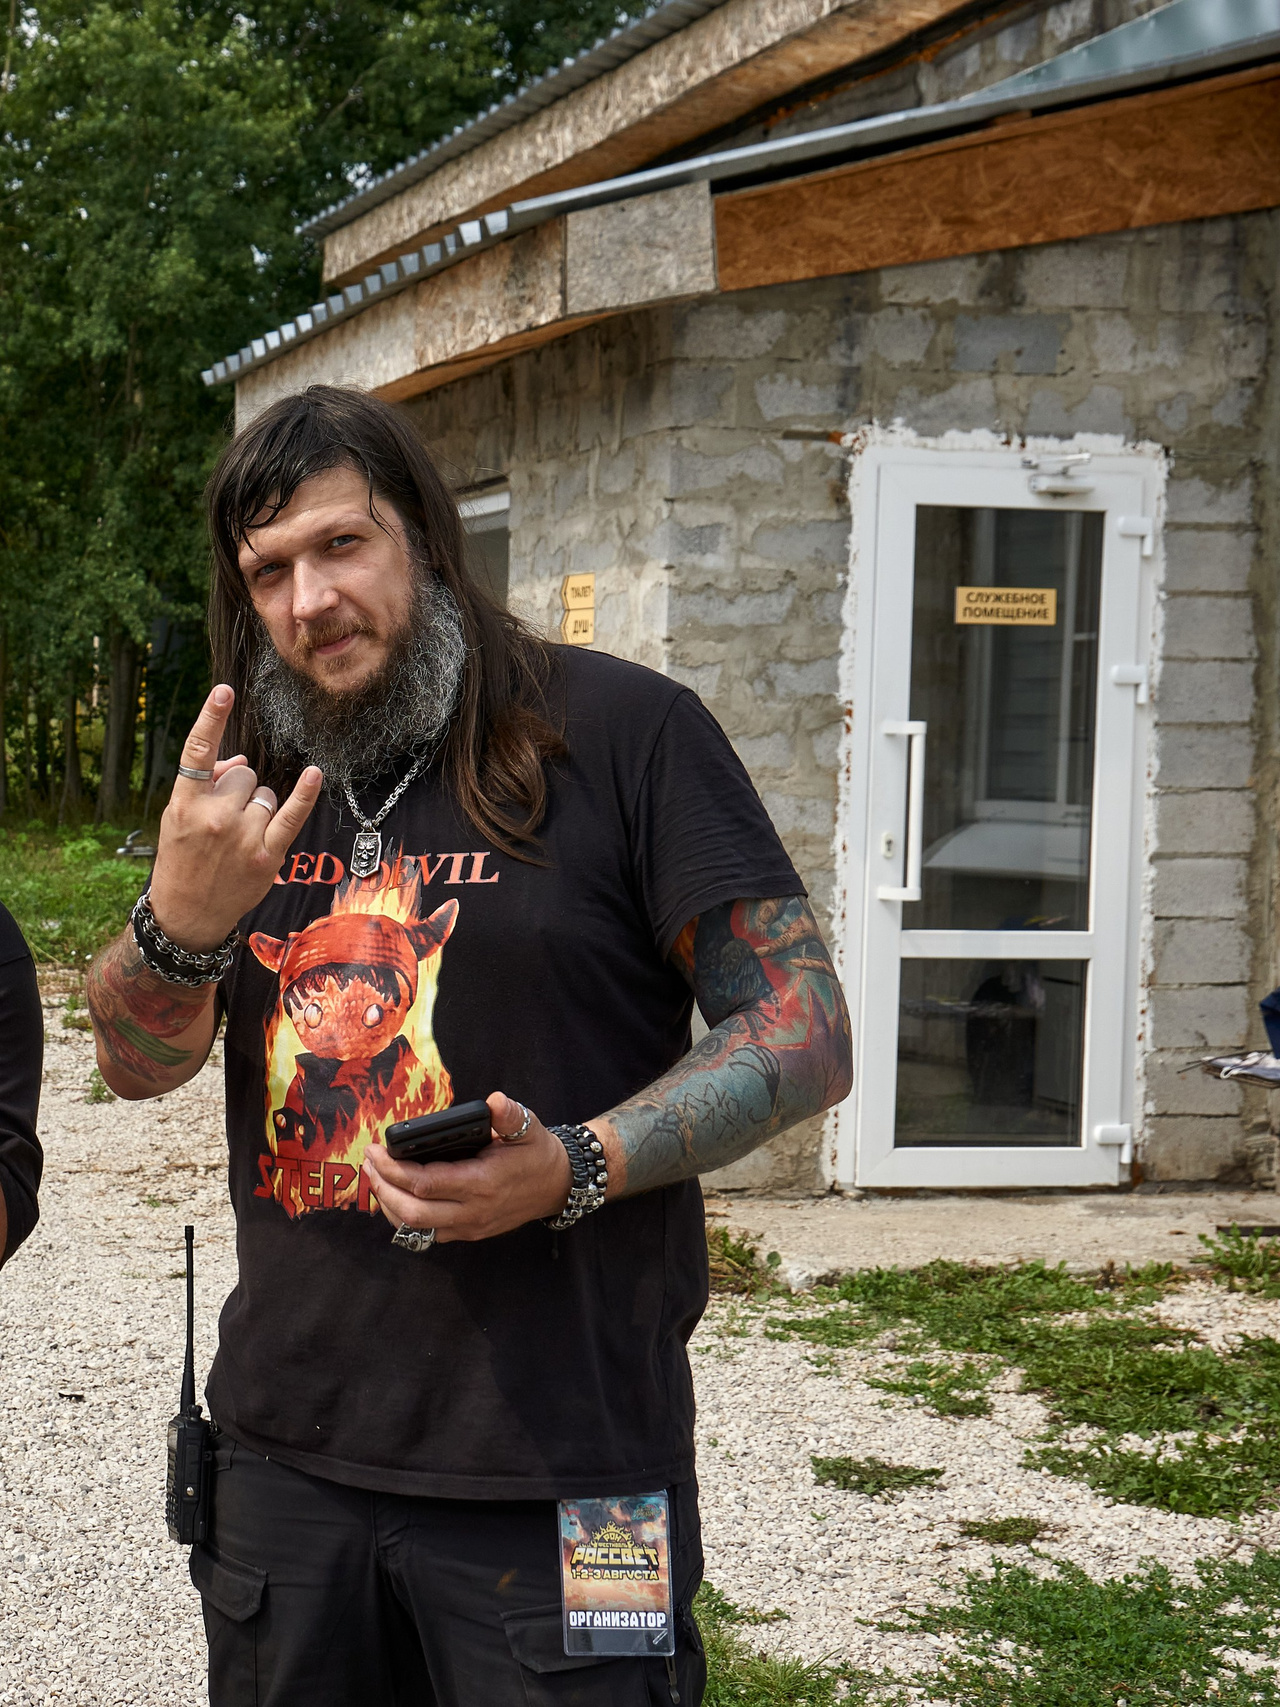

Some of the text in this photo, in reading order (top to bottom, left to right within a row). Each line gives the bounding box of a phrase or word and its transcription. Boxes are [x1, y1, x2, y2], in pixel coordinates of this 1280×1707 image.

[965, 591, 1048, 605] СЛУЖЕБНОЕ
[962, 606, 1050, 621] ПОМЕЩЕНИЕ
[573, 619, 590, 635] ДУШ
[571, 1547, 659, 1566] РАССВЕТ
[571, 1568, 659, 1580] 1-2-3 АВГУСТА
[569, 1610, 667, 1628] ОРГАНИЗАТОР
